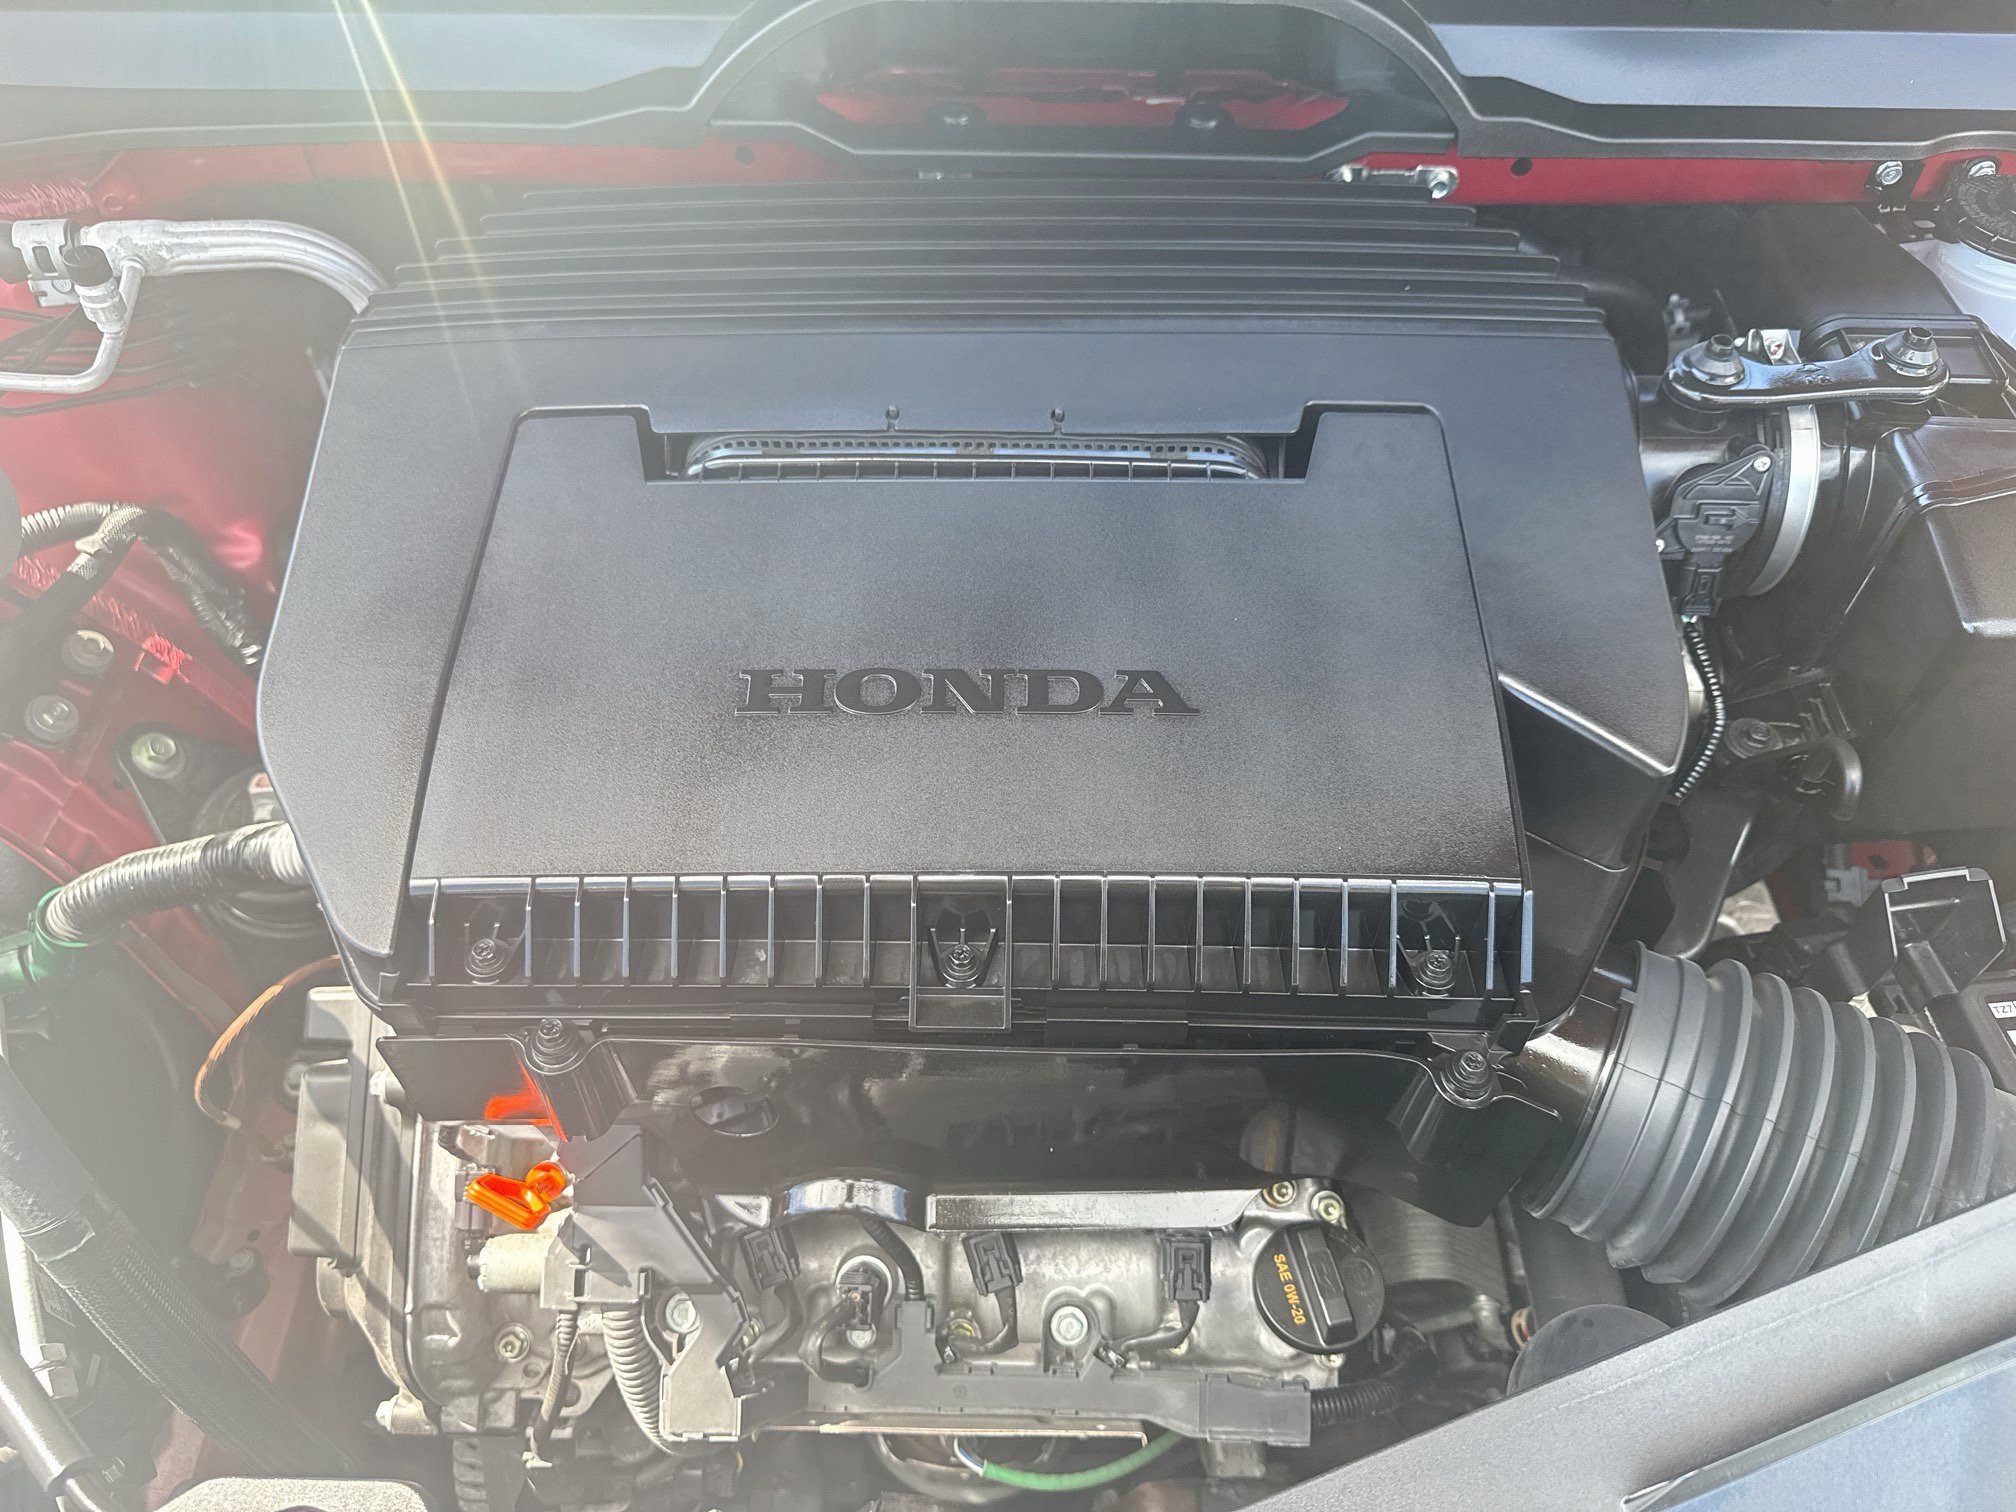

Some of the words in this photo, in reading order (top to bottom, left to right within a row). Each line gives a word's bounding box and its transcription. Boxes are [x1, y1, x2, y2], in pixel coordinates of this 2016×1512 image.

[735, 667, 1199, 716] HONDA
[1273, 1253, 1293, 1282] SAE
[1283, 1283, 1307, 1325] 0W-20
